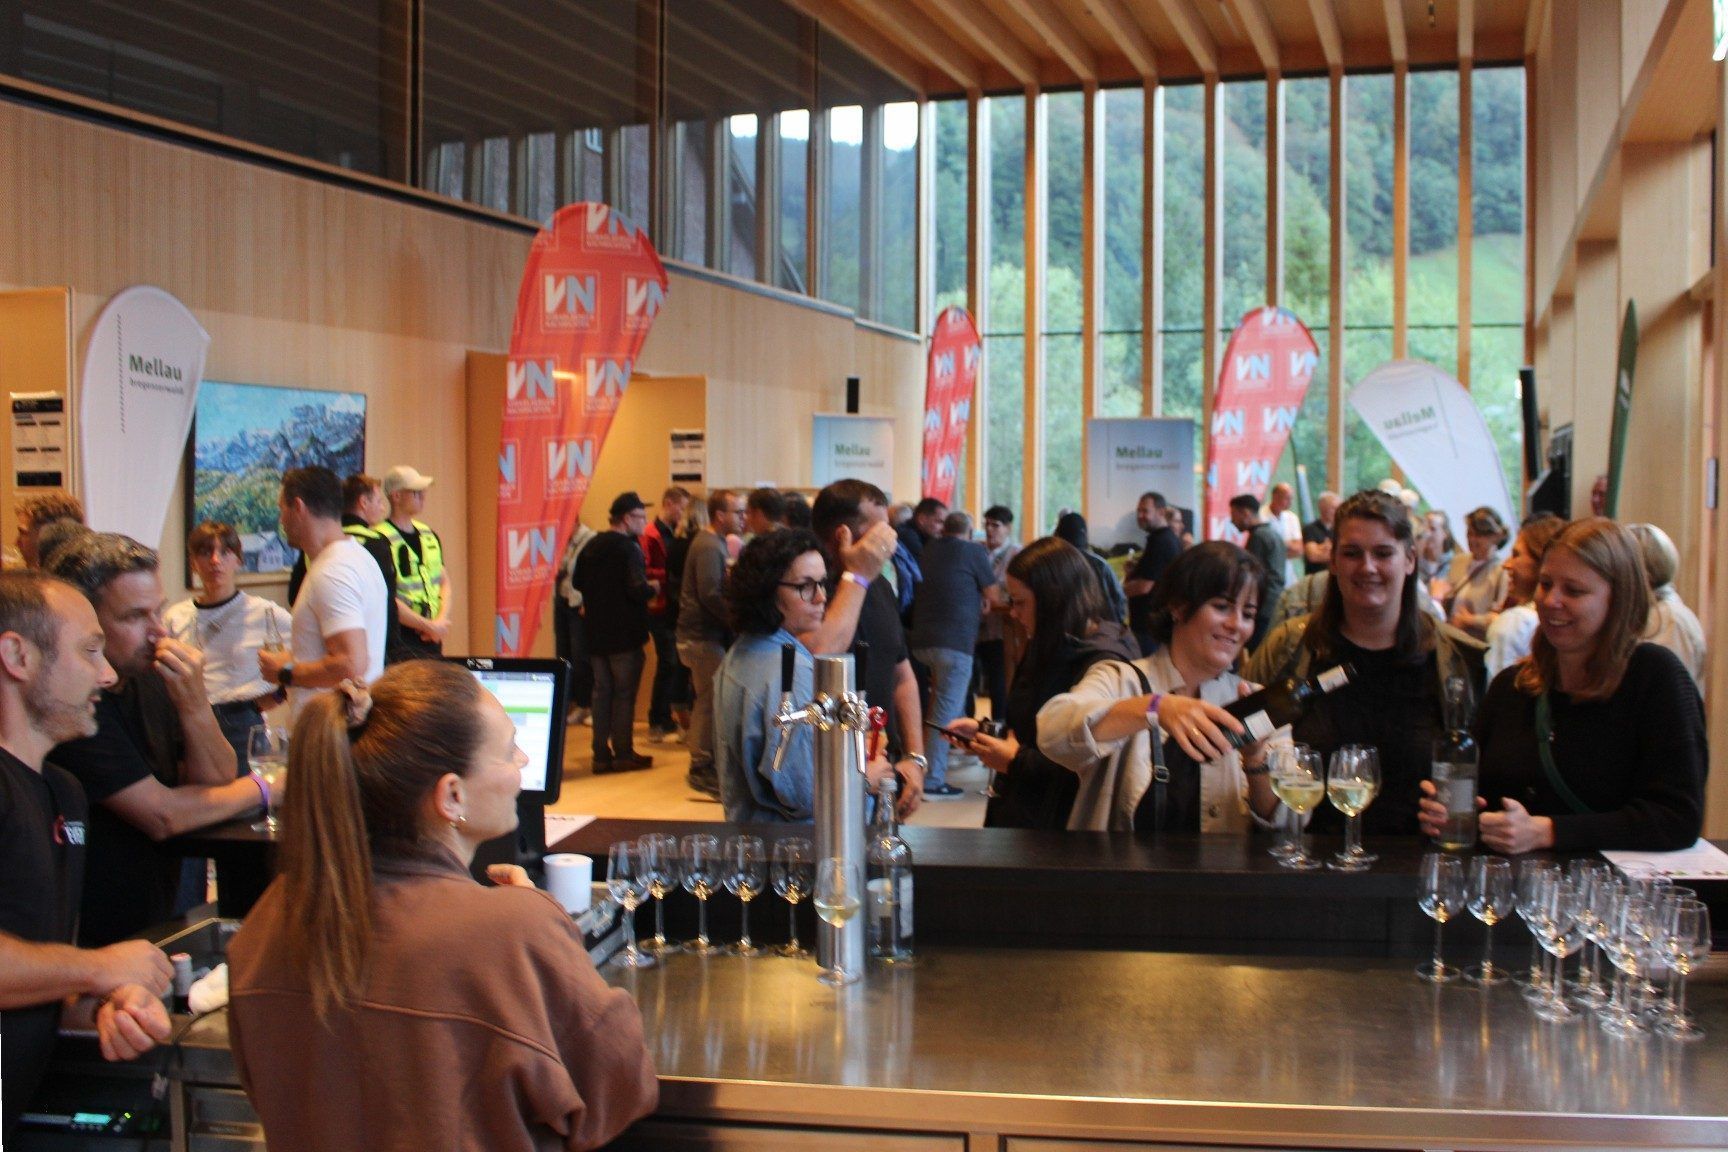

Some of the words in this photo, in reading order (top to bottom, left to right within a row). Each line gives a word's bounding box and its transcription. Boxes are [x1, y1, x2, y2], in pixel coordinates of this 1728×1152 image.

[545, 274, 595, 315] VN
[129, 353, 182, 381] Mellau
[507, 359, 555, 400] VN
[586, 357, 632, 398] VN
[1236, 354, 1271, 380] VN
[1212, 410, 1244, 436] VN
[1263, 406, 1296, 432] VN
[498, 443, 516, 484] N
[547, 439, 594, 481] VN
[1115, 445, 1163, 459] Mellau
[1237, 459, 1270, 487] VN
[507, 527, 556, 570] VN
[495, 612, 521, 654] N
